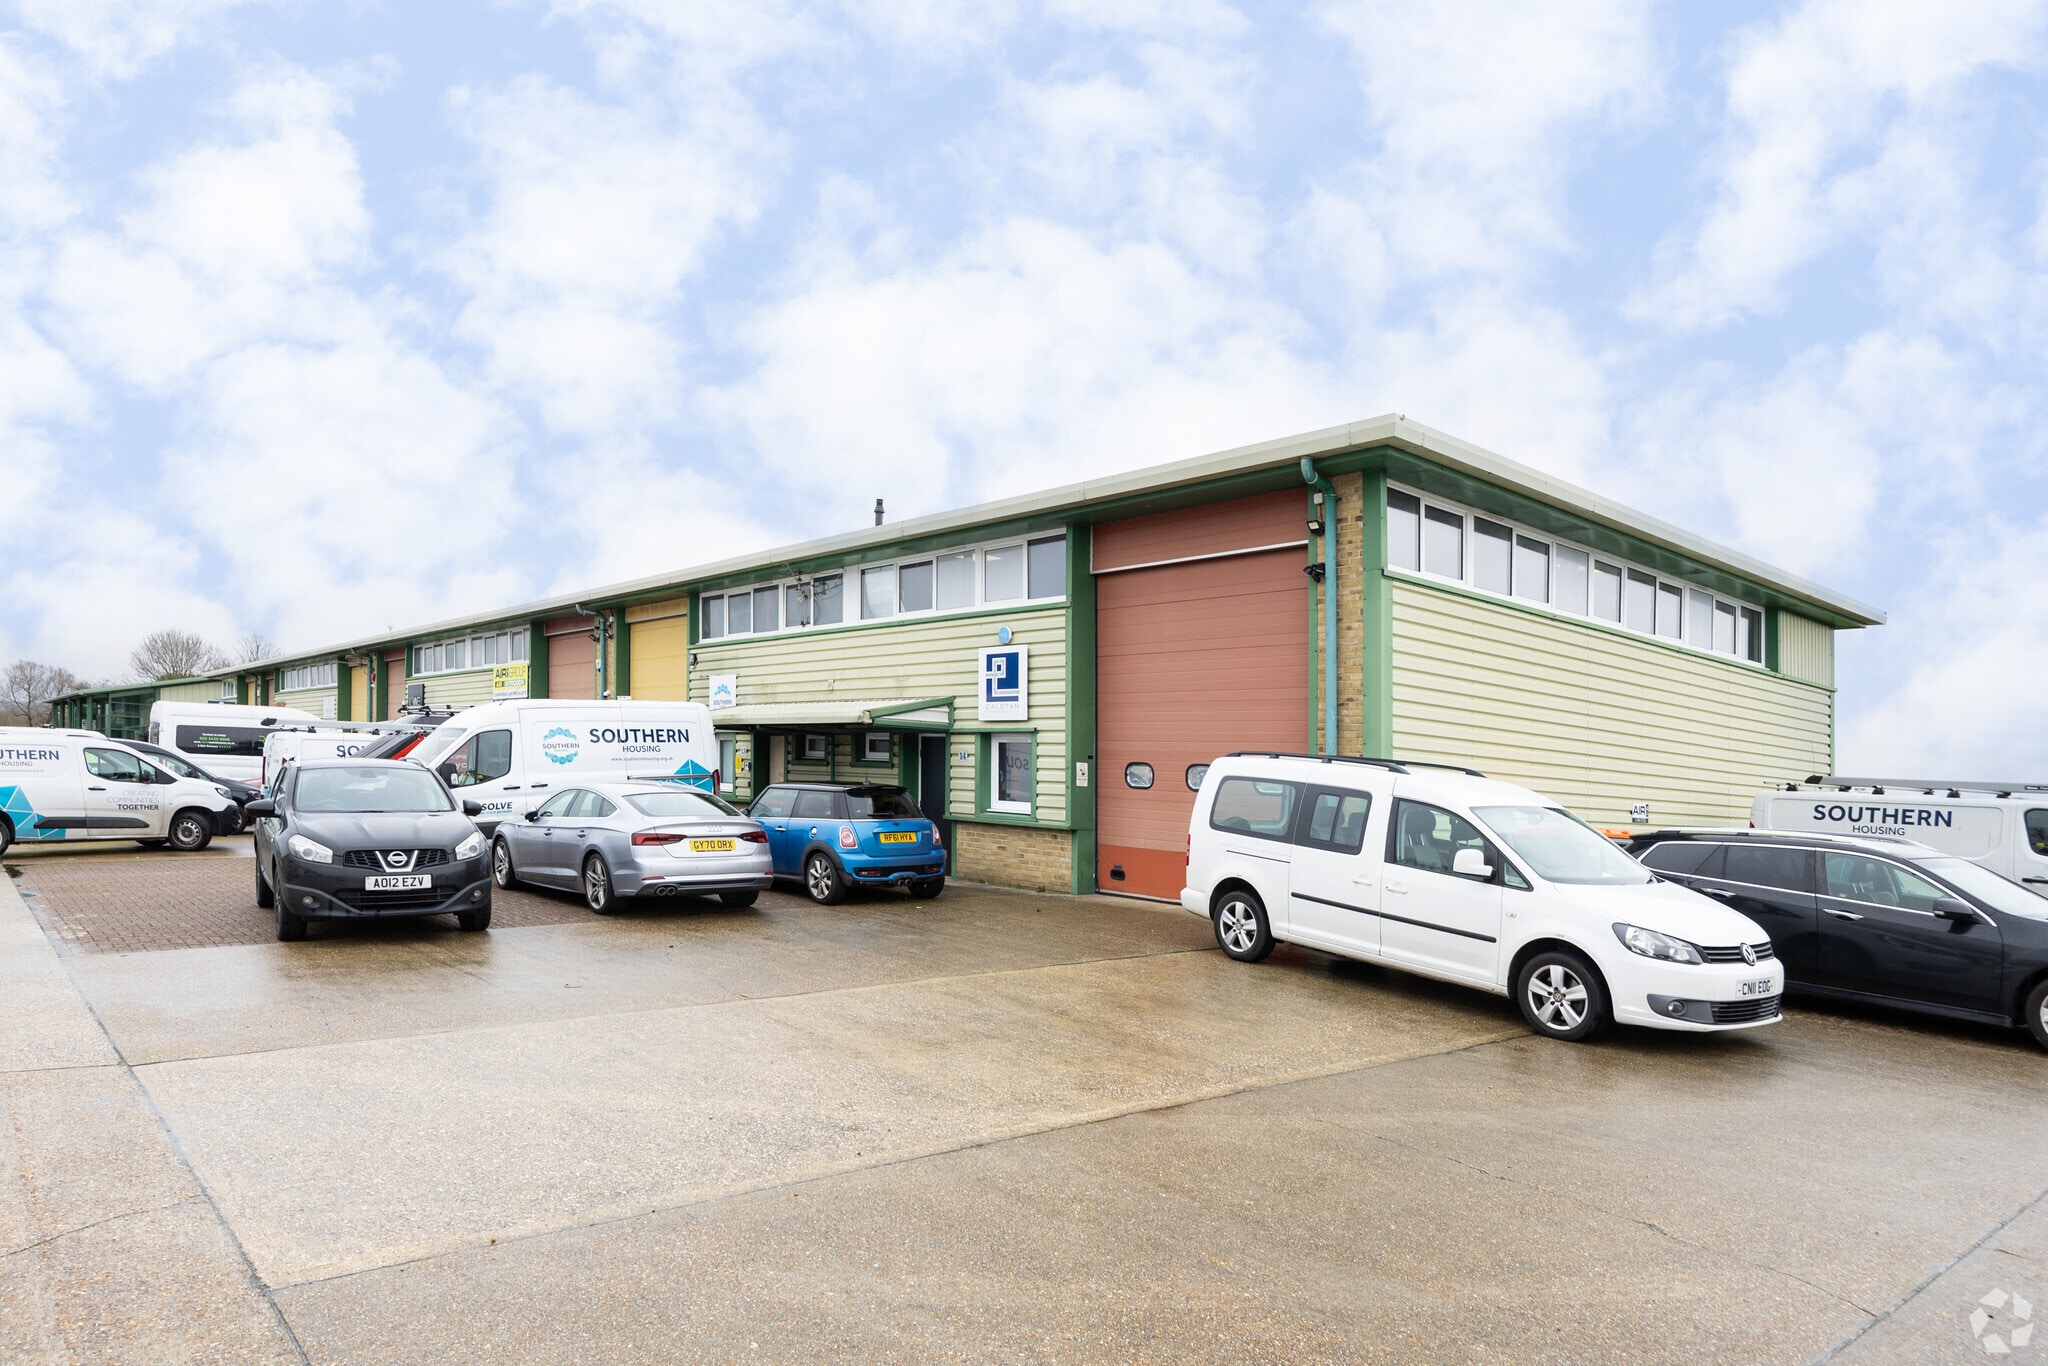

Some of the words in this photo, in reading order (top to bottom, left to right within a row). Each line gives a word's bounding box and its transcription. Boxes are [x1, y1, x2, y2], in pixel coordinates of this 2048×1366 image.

[589, 728, 690, 743] SOUTHERN
[622, 745, 661, 753] HOUSING
[1812, 804, 1953, 828] SOUTHERN
[1852, 825, 1906, 836] HOUSING
[693, 840, 715, 850] GY70
[717, 840, 733, 849] ORX
[373, 877, 399, 889] AO12
[402, 876, 424, 888] EZV
